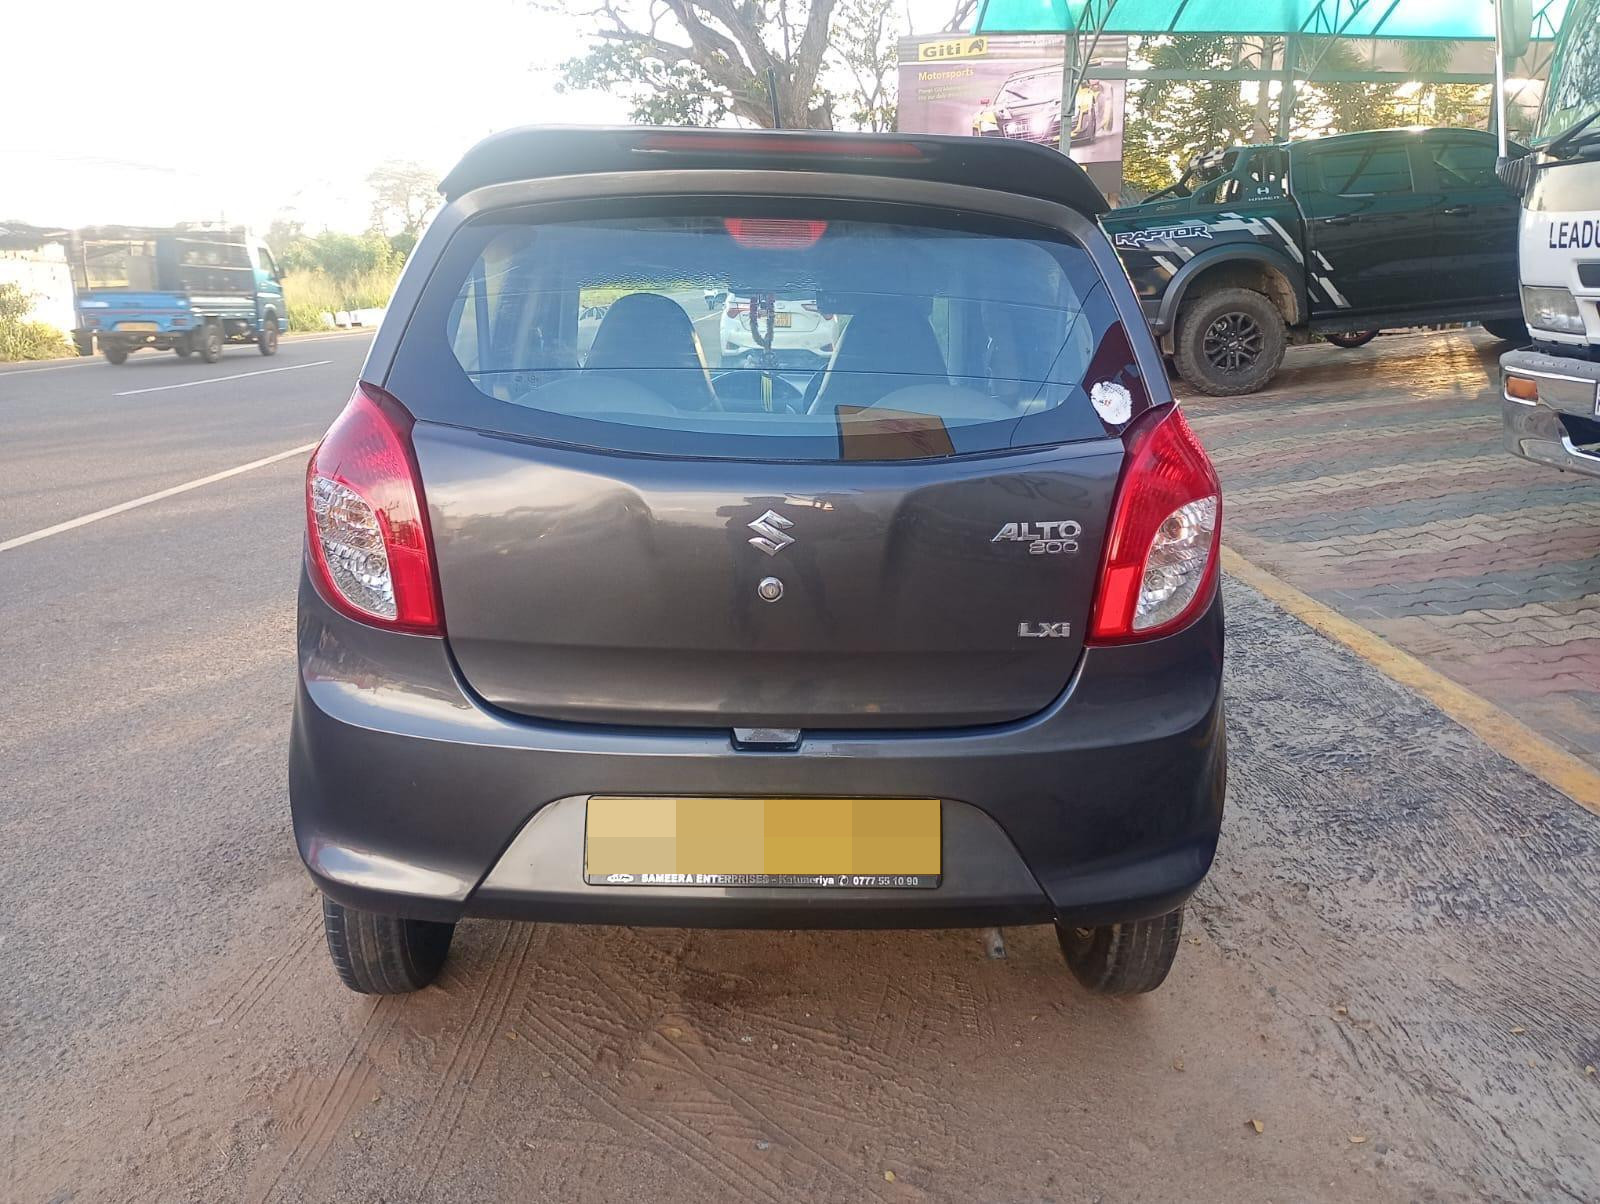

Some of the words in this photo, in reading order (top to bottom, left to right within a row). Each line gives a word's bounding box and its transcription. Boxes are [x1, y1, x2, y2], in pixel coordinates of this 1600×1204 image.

[923, 43, 961, 58] Giti
[919, 67, 974, 81] Motorsports
[1115, 225, 1213, 248] RAPTOR
[990, 520, 1082, 542] ALTO
[1029, 540, 1079, 555] 800
[1018, 622, 1071, 637] LXi
[696, 873, 769, 884] ENTERPRISES
[853, 876, 876, 886] 0777
[878, 876, 890, 886] 55
[893, 876, 904, 886] 10
[906, 876, 918, 886] 90
